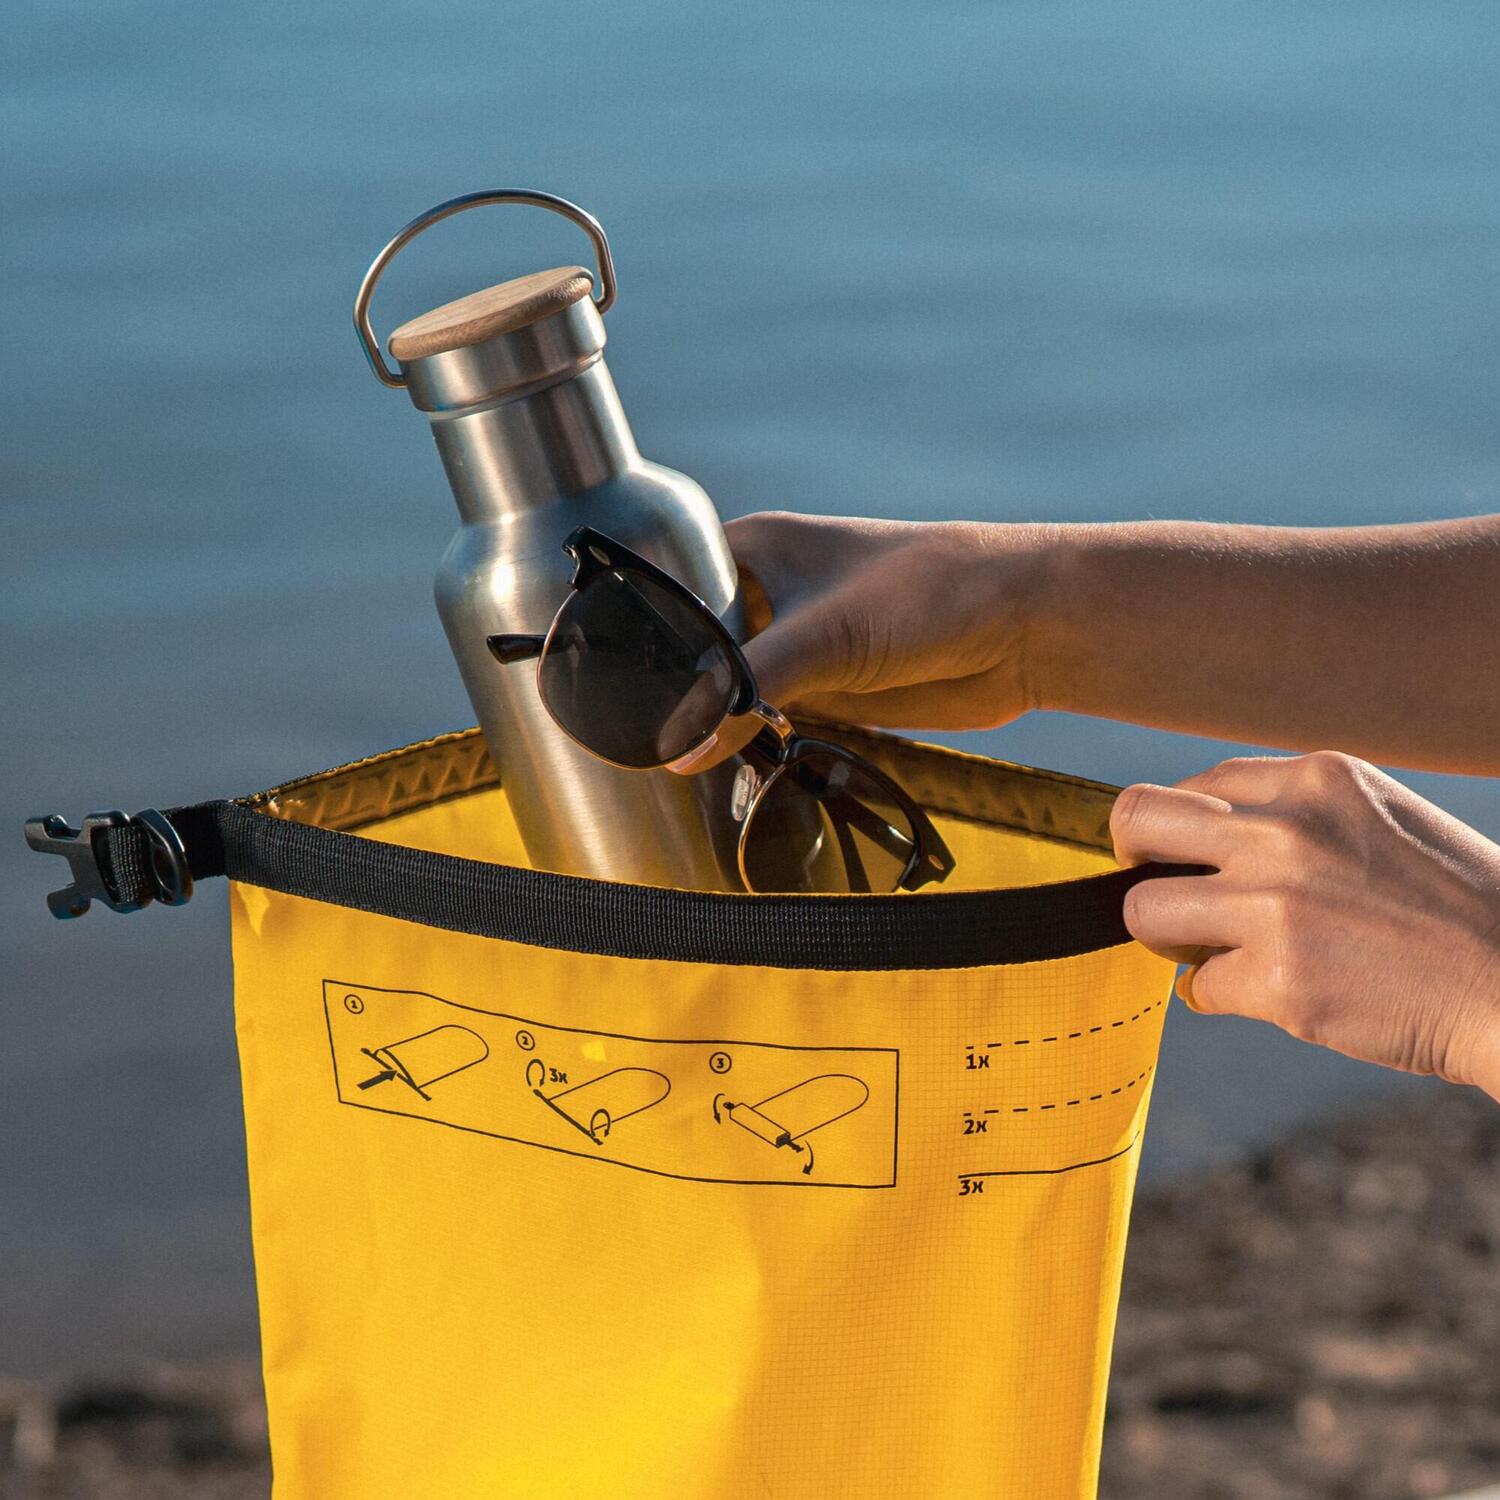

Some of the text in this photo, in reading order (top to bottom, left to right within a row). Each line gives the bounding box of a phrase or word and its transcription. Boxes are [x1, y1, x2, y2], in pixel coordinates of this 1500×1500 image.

[965, 1053, 990, 1070] 1x
[549, 1067, 568, 1084] 3x
[963, 1119, 988, 1135] 2x
[958, 1179, 984, 1196] 3x
